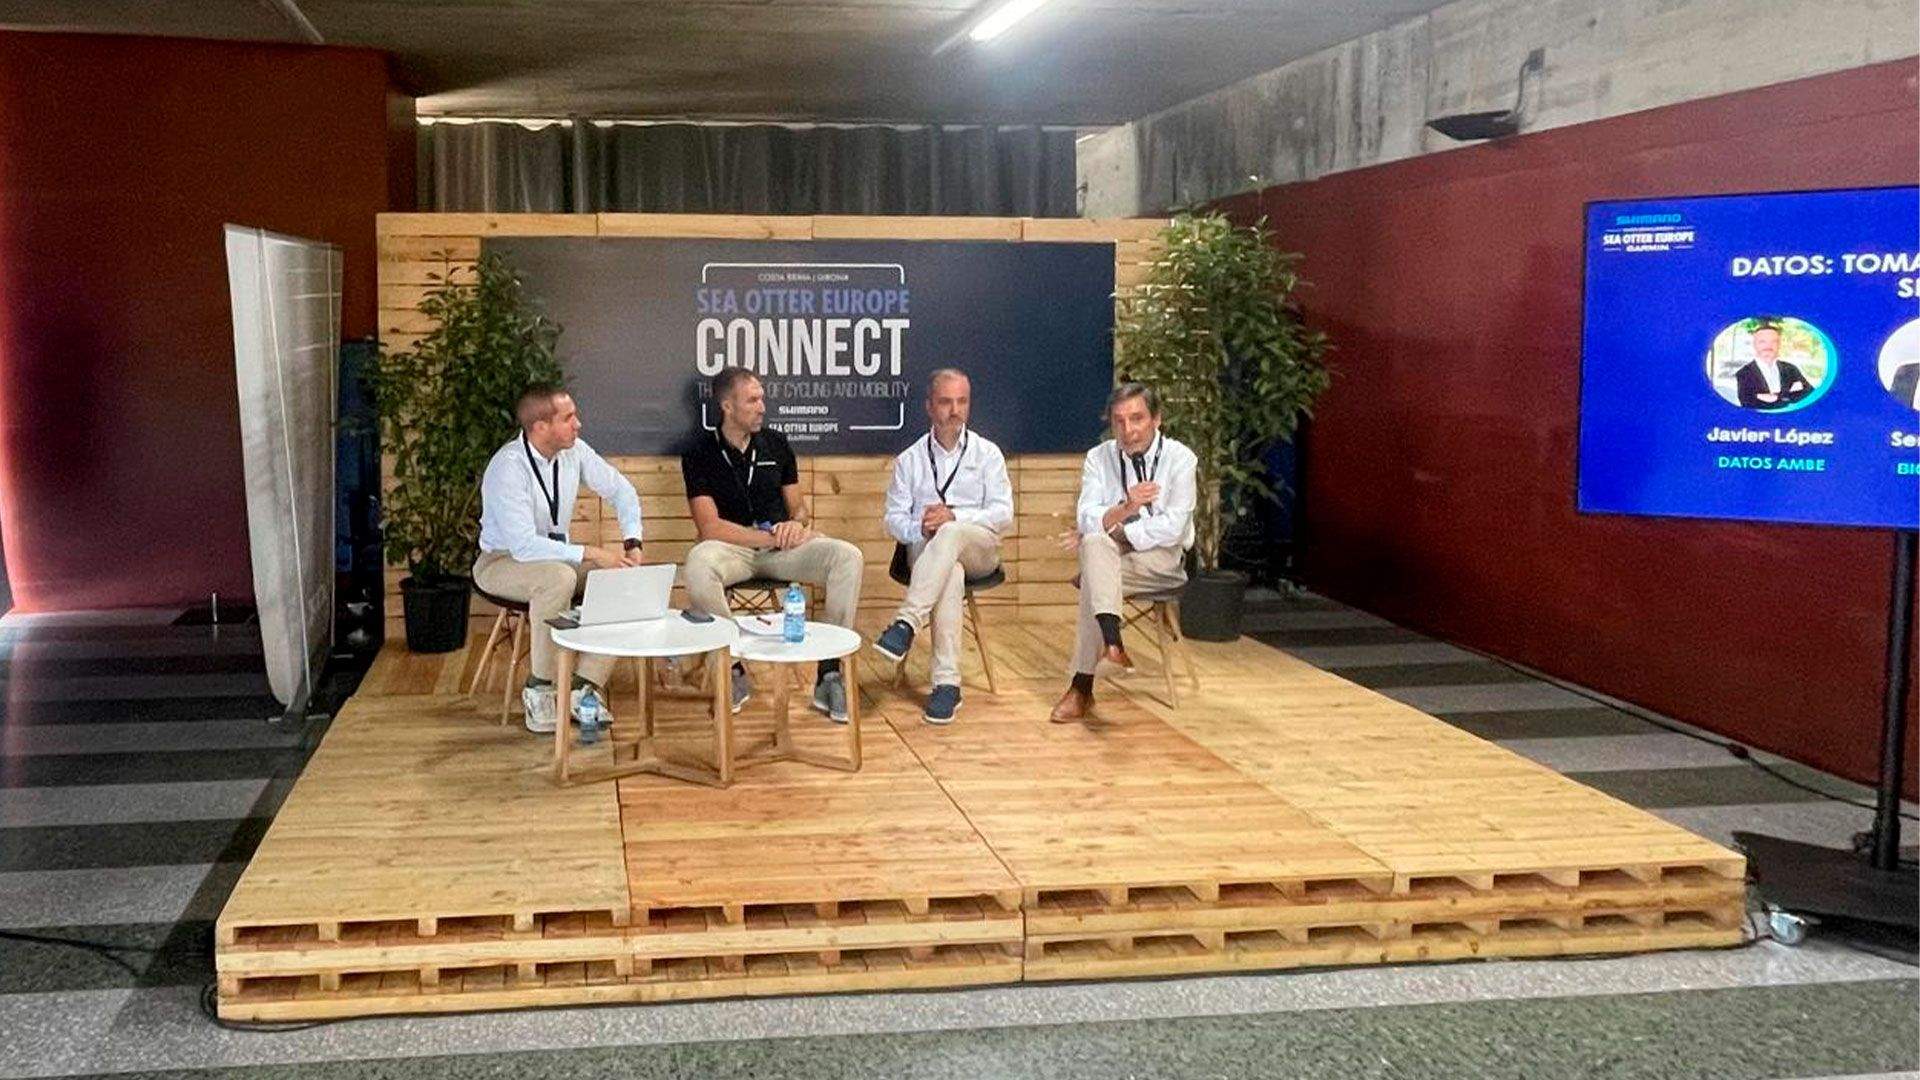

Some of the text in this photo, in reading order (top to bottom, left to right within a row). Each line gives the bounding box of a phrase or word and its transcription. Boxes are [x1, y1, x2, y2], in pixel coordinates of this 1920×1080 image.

[1603, 231, 1694, 245] SEA OTTER EUROPE
[1732, 255, 1834, 276] DATOS:
[697, 289, 909, 314] SEA OTTER EUROPE
[696, 318, 910, 376] CONNECT
[784, 382, 830, 398] CYCLING
[834, 382, 857, 398] AND
[859, 382, 909, 398] MOBILITY
[778, 405, 829, 415] SHIMANO
[784, 422, 807, 433] OTTER
[809, 422, 838, 433] EUROPE
[1707, 427, 1834, 446] Javier López
[1890, 430, 1920, 447] Se
[1718, 456, 1826, 471] DATOS AMBE
